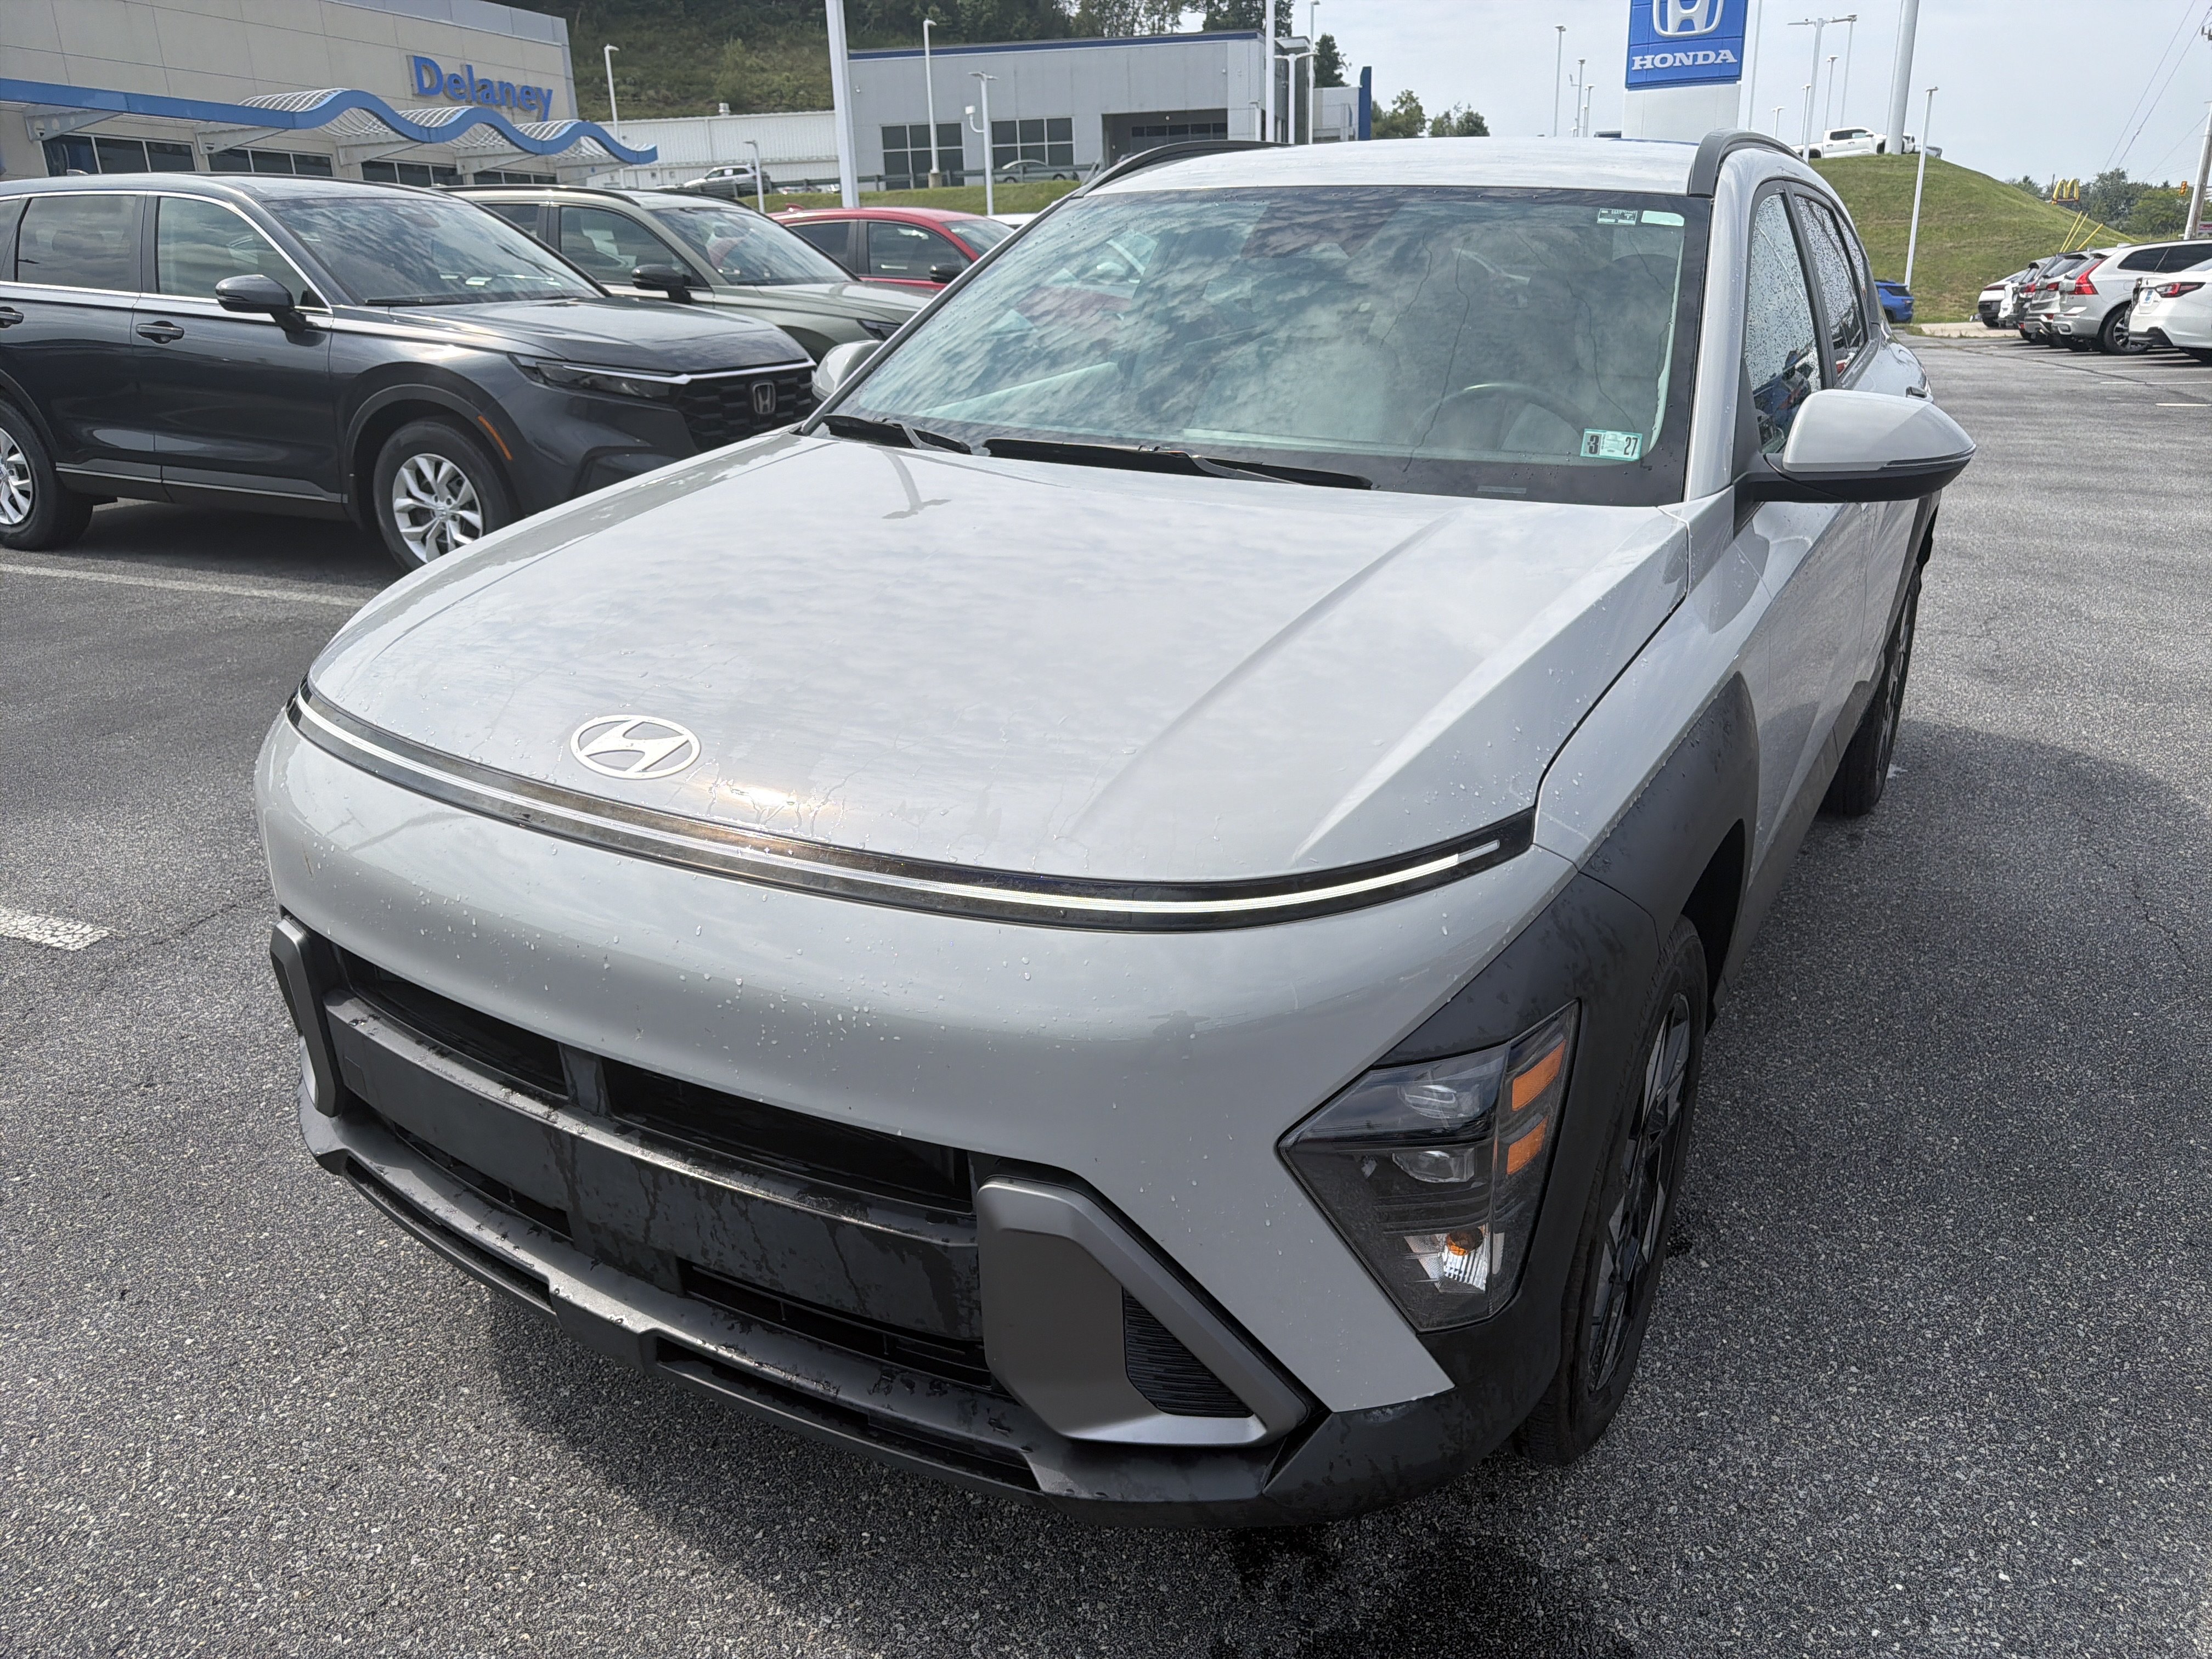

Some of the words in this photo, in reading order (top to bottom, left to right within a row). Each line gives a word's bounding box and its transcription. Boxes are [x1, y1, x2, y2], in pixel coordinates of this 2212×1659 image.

[1631, 49, 1738, 70] HONDA
[412, 55, 554, 122] Delaney
[1588, 435, 1600, 454] 3
[1623, 436, 1639, 457] 27
